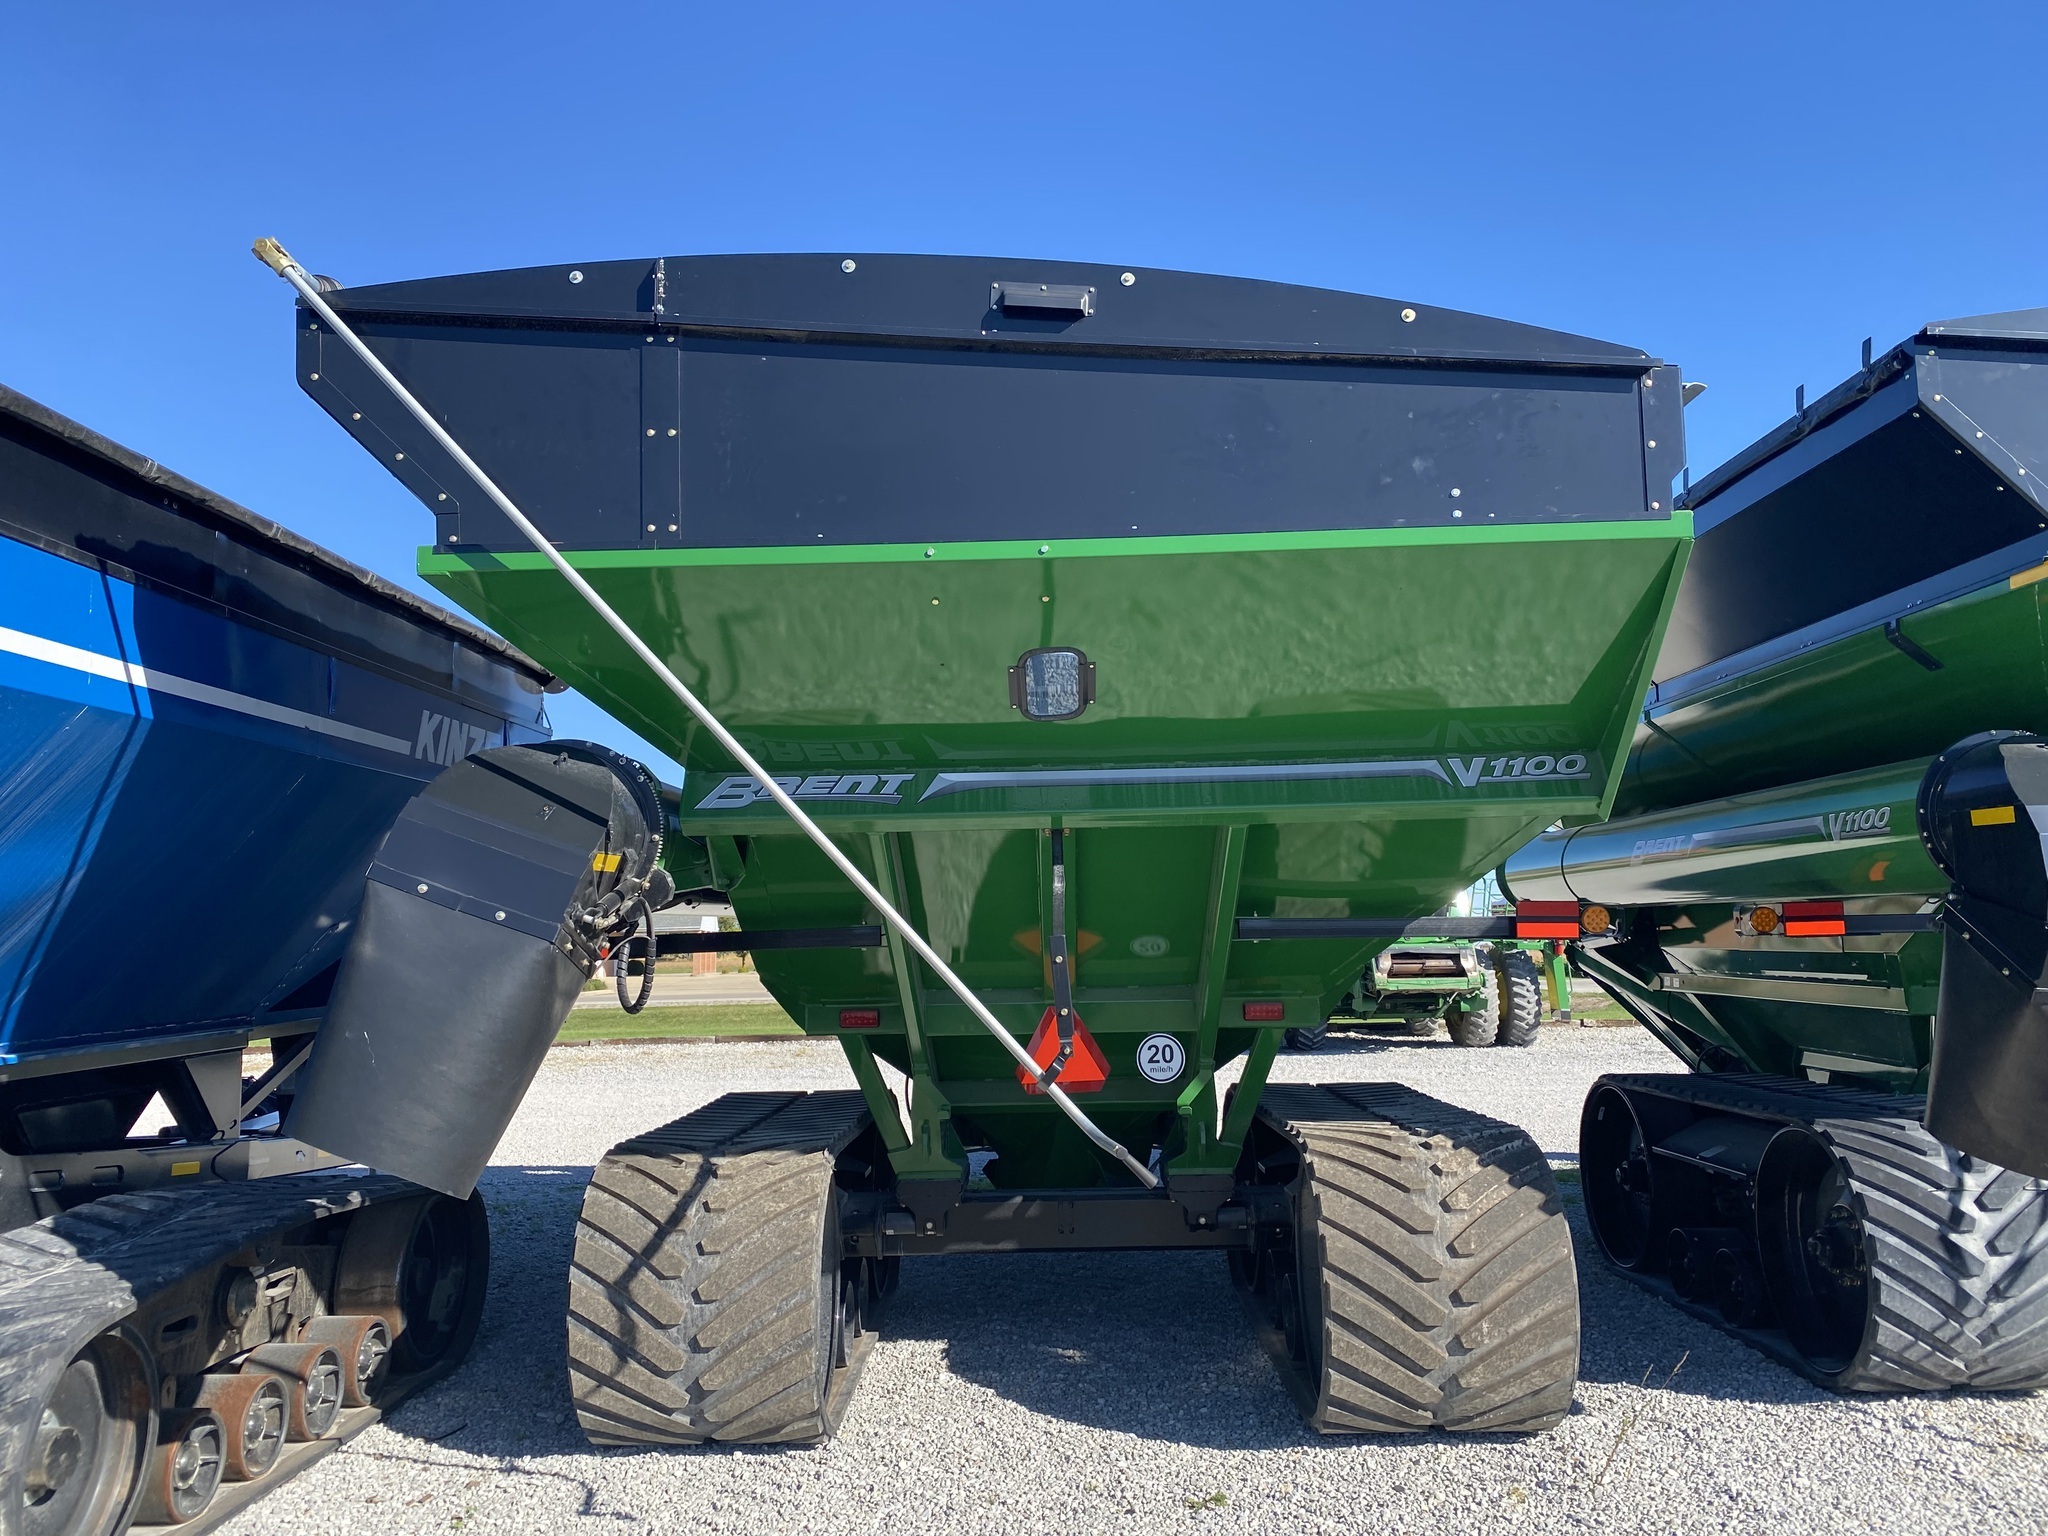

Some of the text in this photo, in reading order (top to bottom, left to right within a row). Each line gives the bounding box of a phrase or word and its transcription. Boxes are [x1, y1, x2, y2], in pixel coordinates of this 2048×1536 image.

[1447, 754, 1588, 787] V1100
[694, 773, 915, 810] BRENT
[1828, 806, 1891, 842] V1100
[1147, 1044, 1175, 1064] 20
[1150, 1065, 1174, 1074] mile/h
